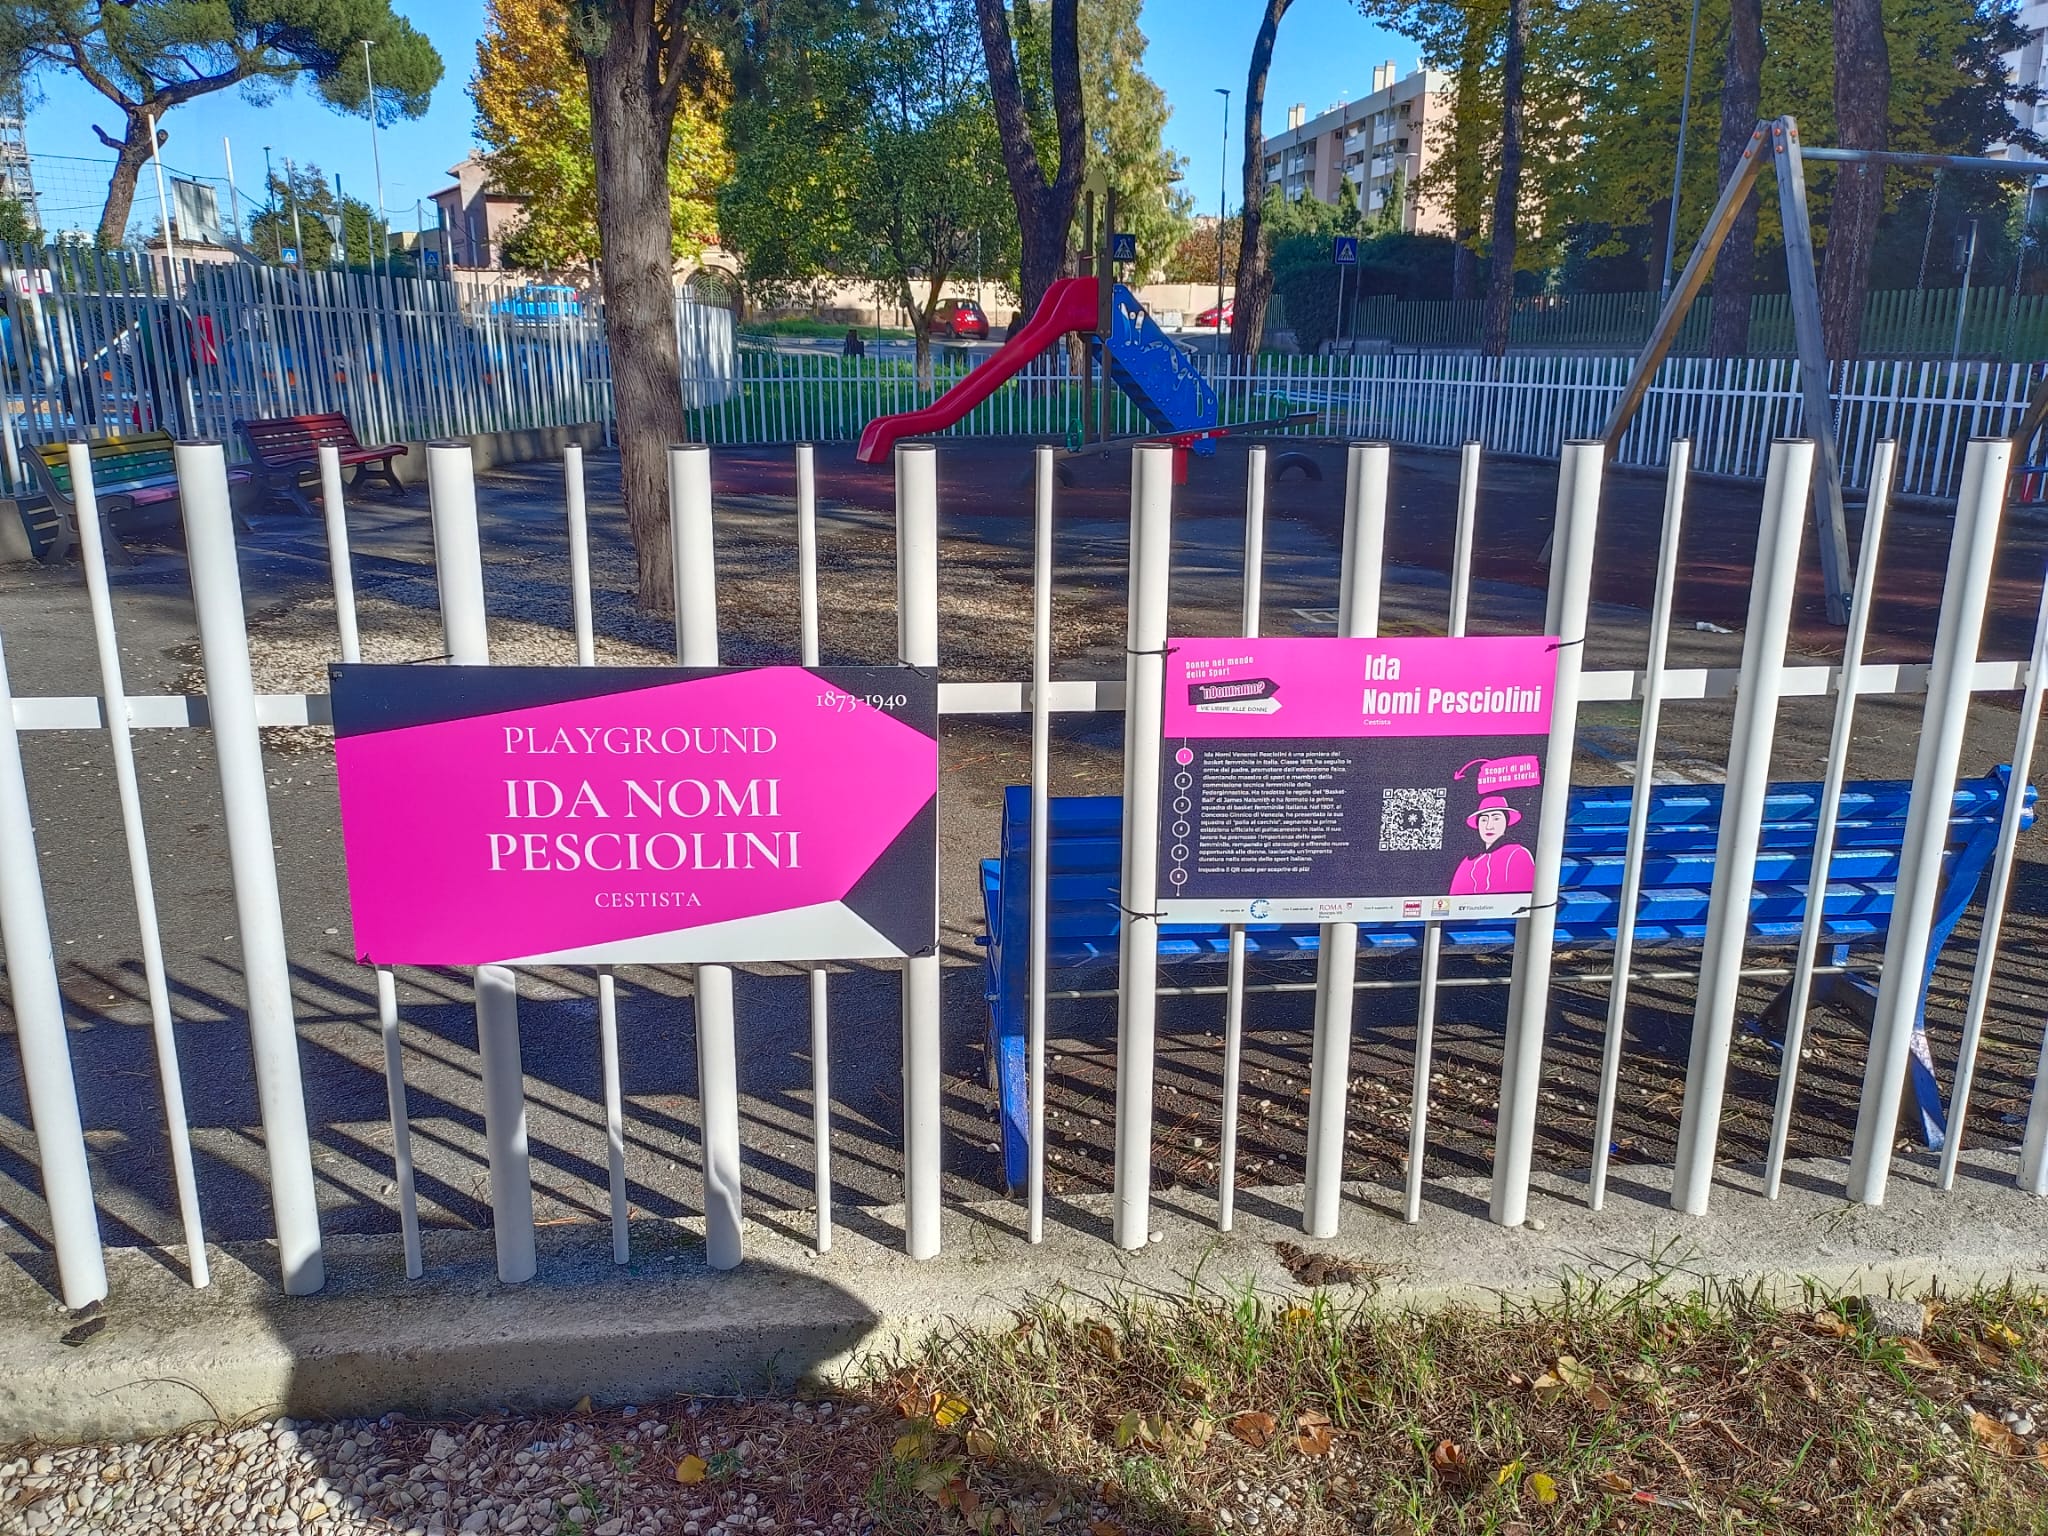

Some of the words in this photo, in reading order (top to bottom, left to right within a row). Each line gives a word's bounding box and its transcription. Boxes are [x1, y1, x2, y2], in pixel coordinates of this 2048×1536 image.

[1185, 660, 1210, 669] Donne
[1212, 659, 1225, 667] nel
[1228, 656, 1254, 666] mondo
[1186, 670, 1206, 679] dello
[1209, 667, 1230, 678] Sport
[1365, 654, 1401, 681] Ida
[815, 690, 907, 713] 1873-1940
[1362, 687, 1421, 715] Nomi
[1427, 685, 1542, 714] Pesciolini
[502, 726, 778, 754] PLAYGROUND
[1477, 776, 1496, 785] sulla
[1484, 765, 1508, 775] Scopri
[1510, 764, 1517, 772] di
[503, 779, 611, 818] IDA
[622, 778, 782, 818] NOMI
[486, 831, 802, 872] PESCIOLINI
[594, 891, 702, 909] CESTISTA
